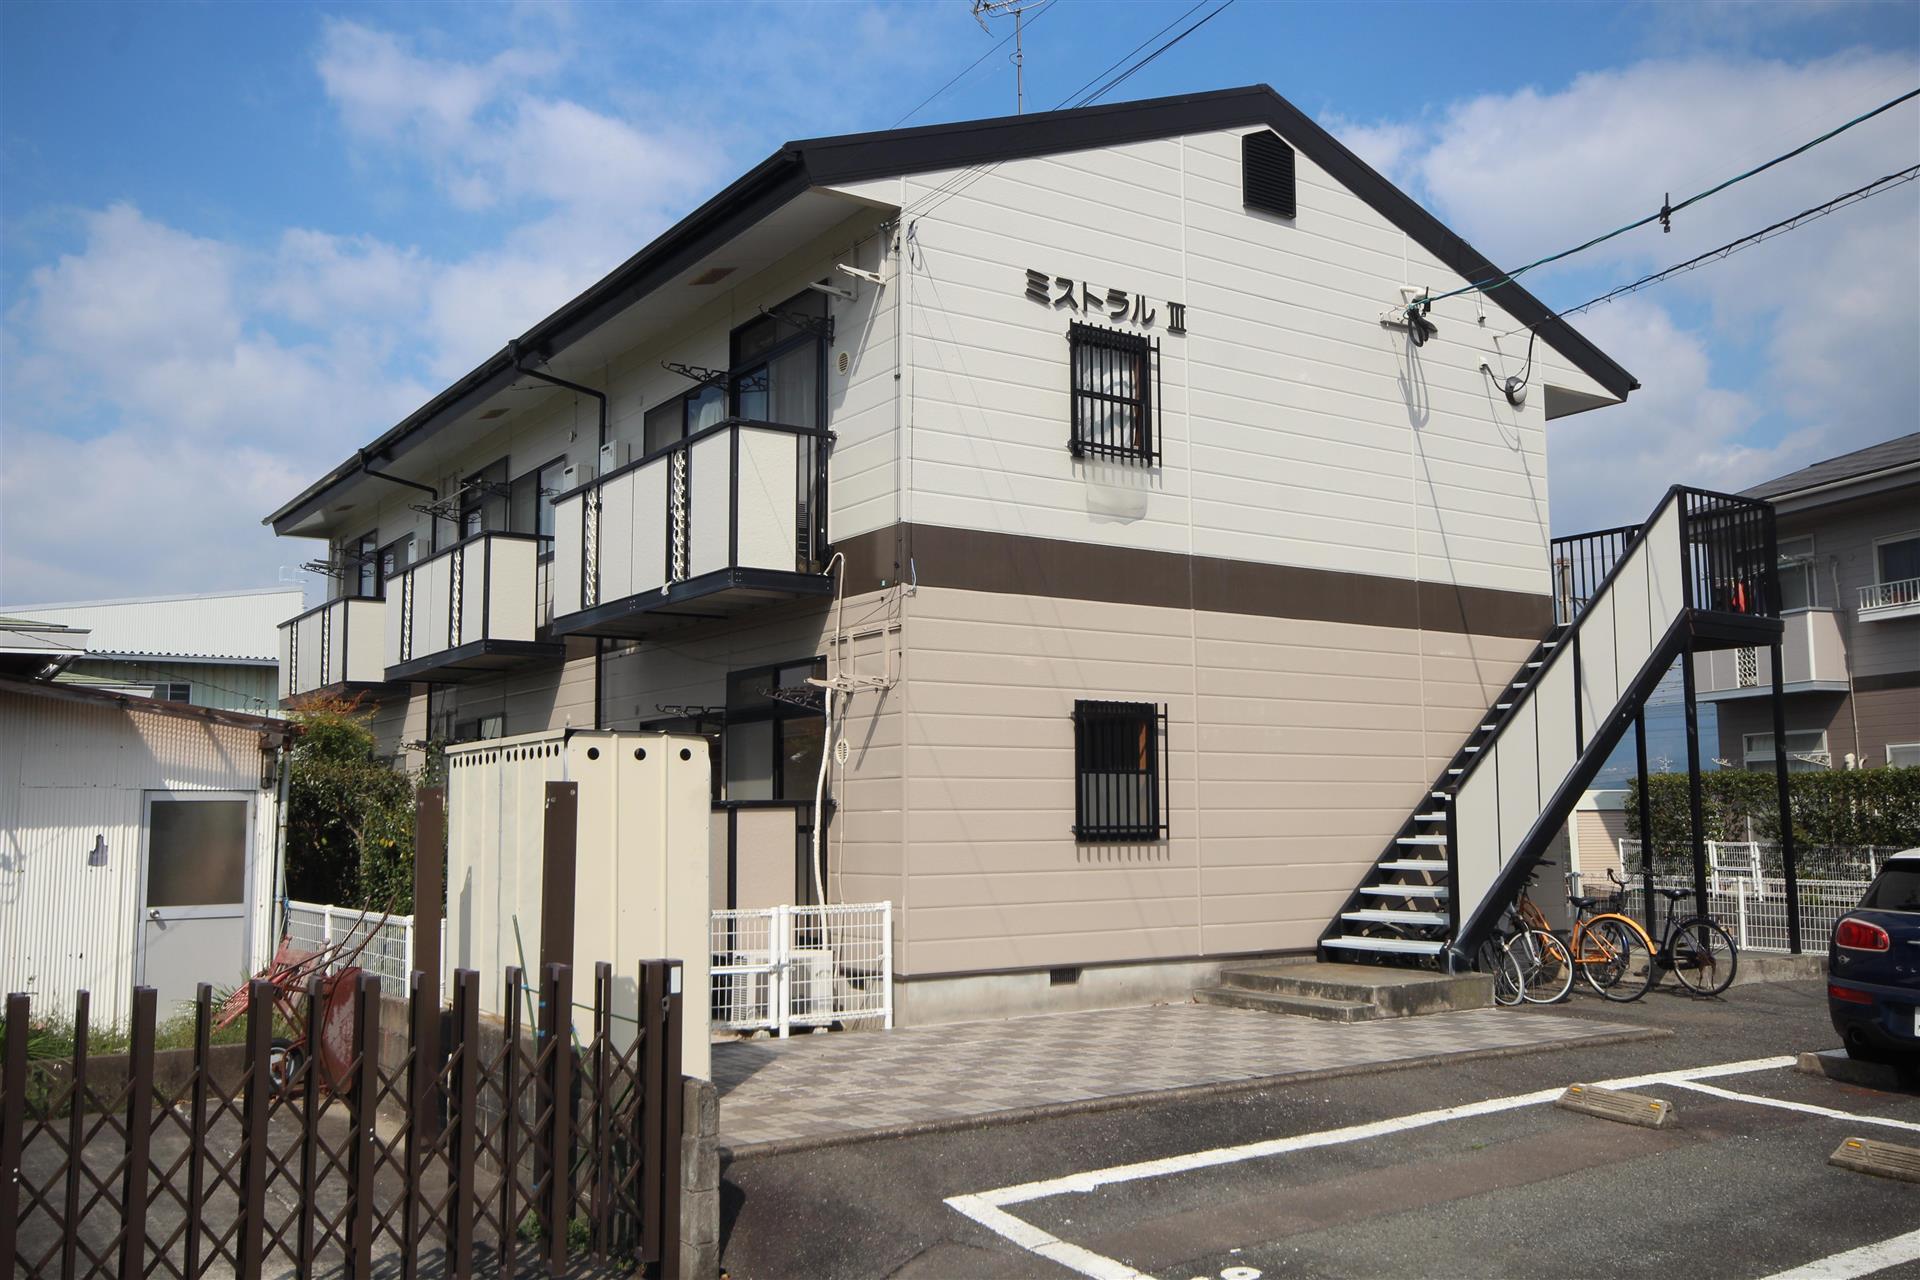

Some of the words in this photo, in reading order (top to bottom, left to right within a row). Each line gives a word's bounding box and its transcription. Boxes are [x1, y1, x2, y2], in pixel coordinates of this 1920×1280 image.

[1026, 269, 1156, 325] ミストラル
